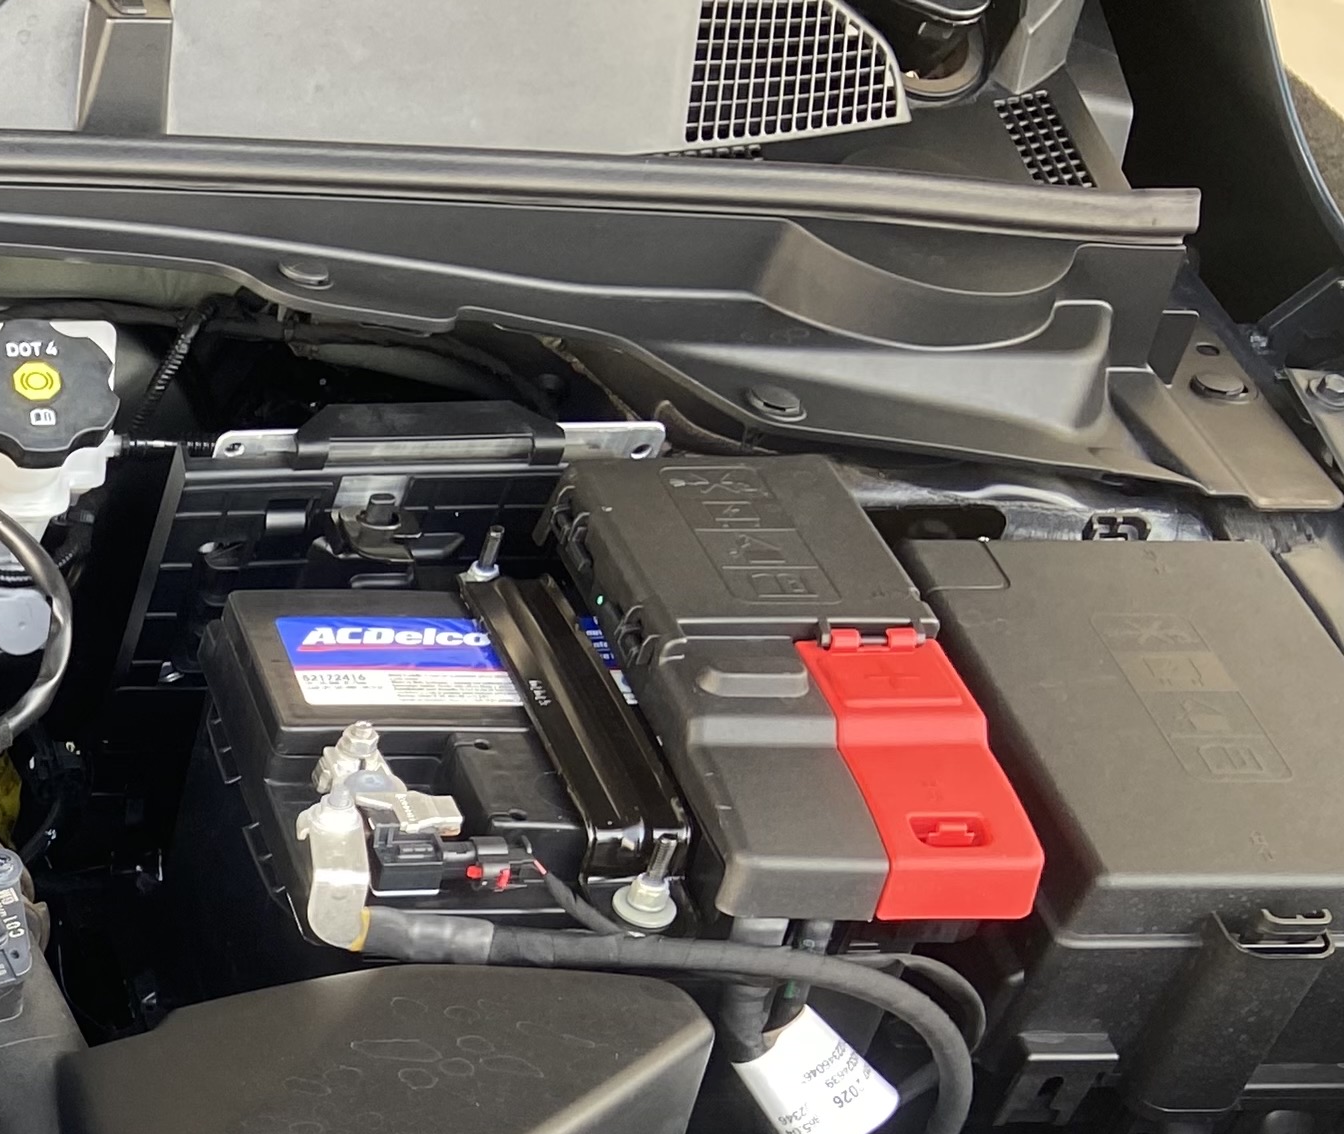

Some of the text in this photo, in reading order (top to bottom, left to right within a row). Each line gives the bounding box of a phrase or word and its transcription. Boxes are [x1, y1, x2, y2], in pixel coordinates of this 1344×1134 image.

[5, 340, 58, 357] DOT 4
[302, 627, 491, 647] ACDelco
